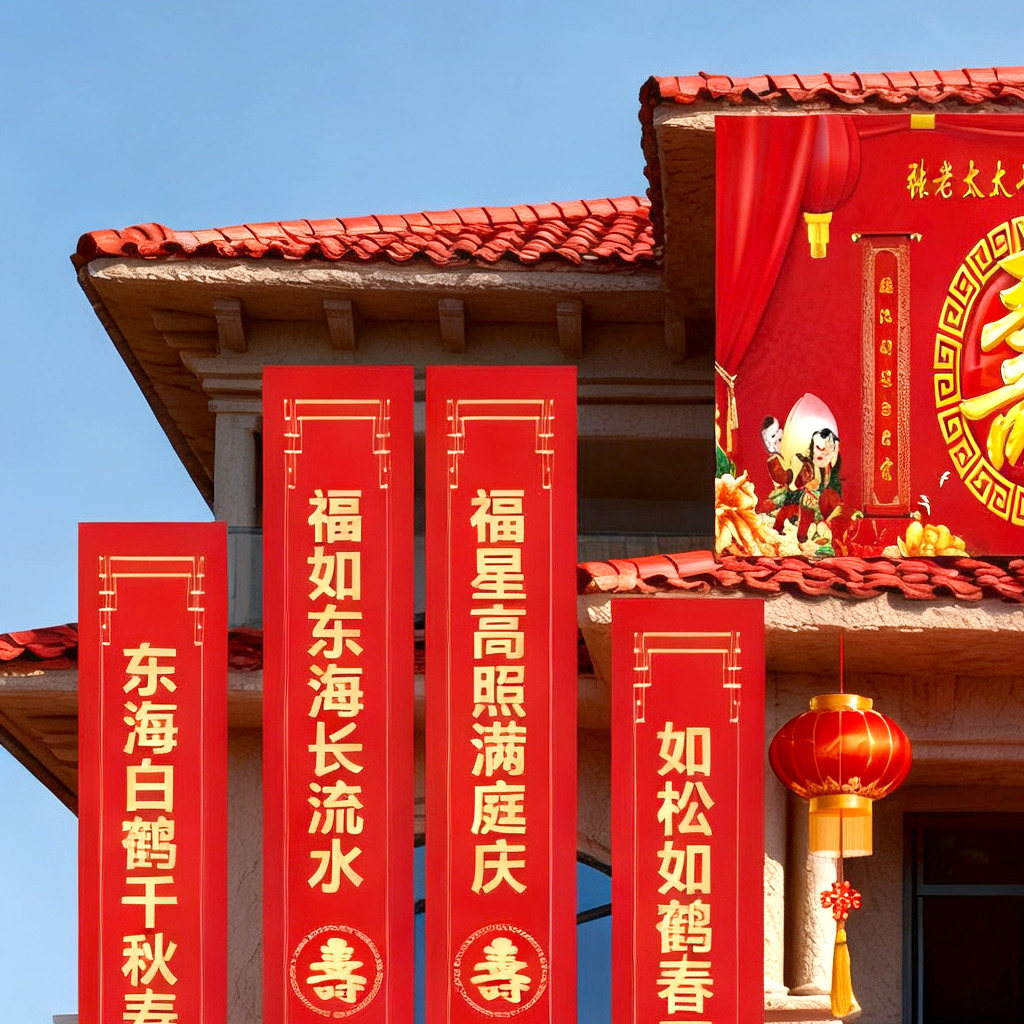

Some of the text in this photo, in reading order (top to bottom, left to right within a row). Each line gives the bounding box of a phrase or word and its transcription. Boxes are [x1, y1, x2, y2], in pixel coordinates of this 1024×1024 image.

[308, 489, 363, 893] 福如东海长流水
[470, 489, 526, 893] 福星高照满庭庆
